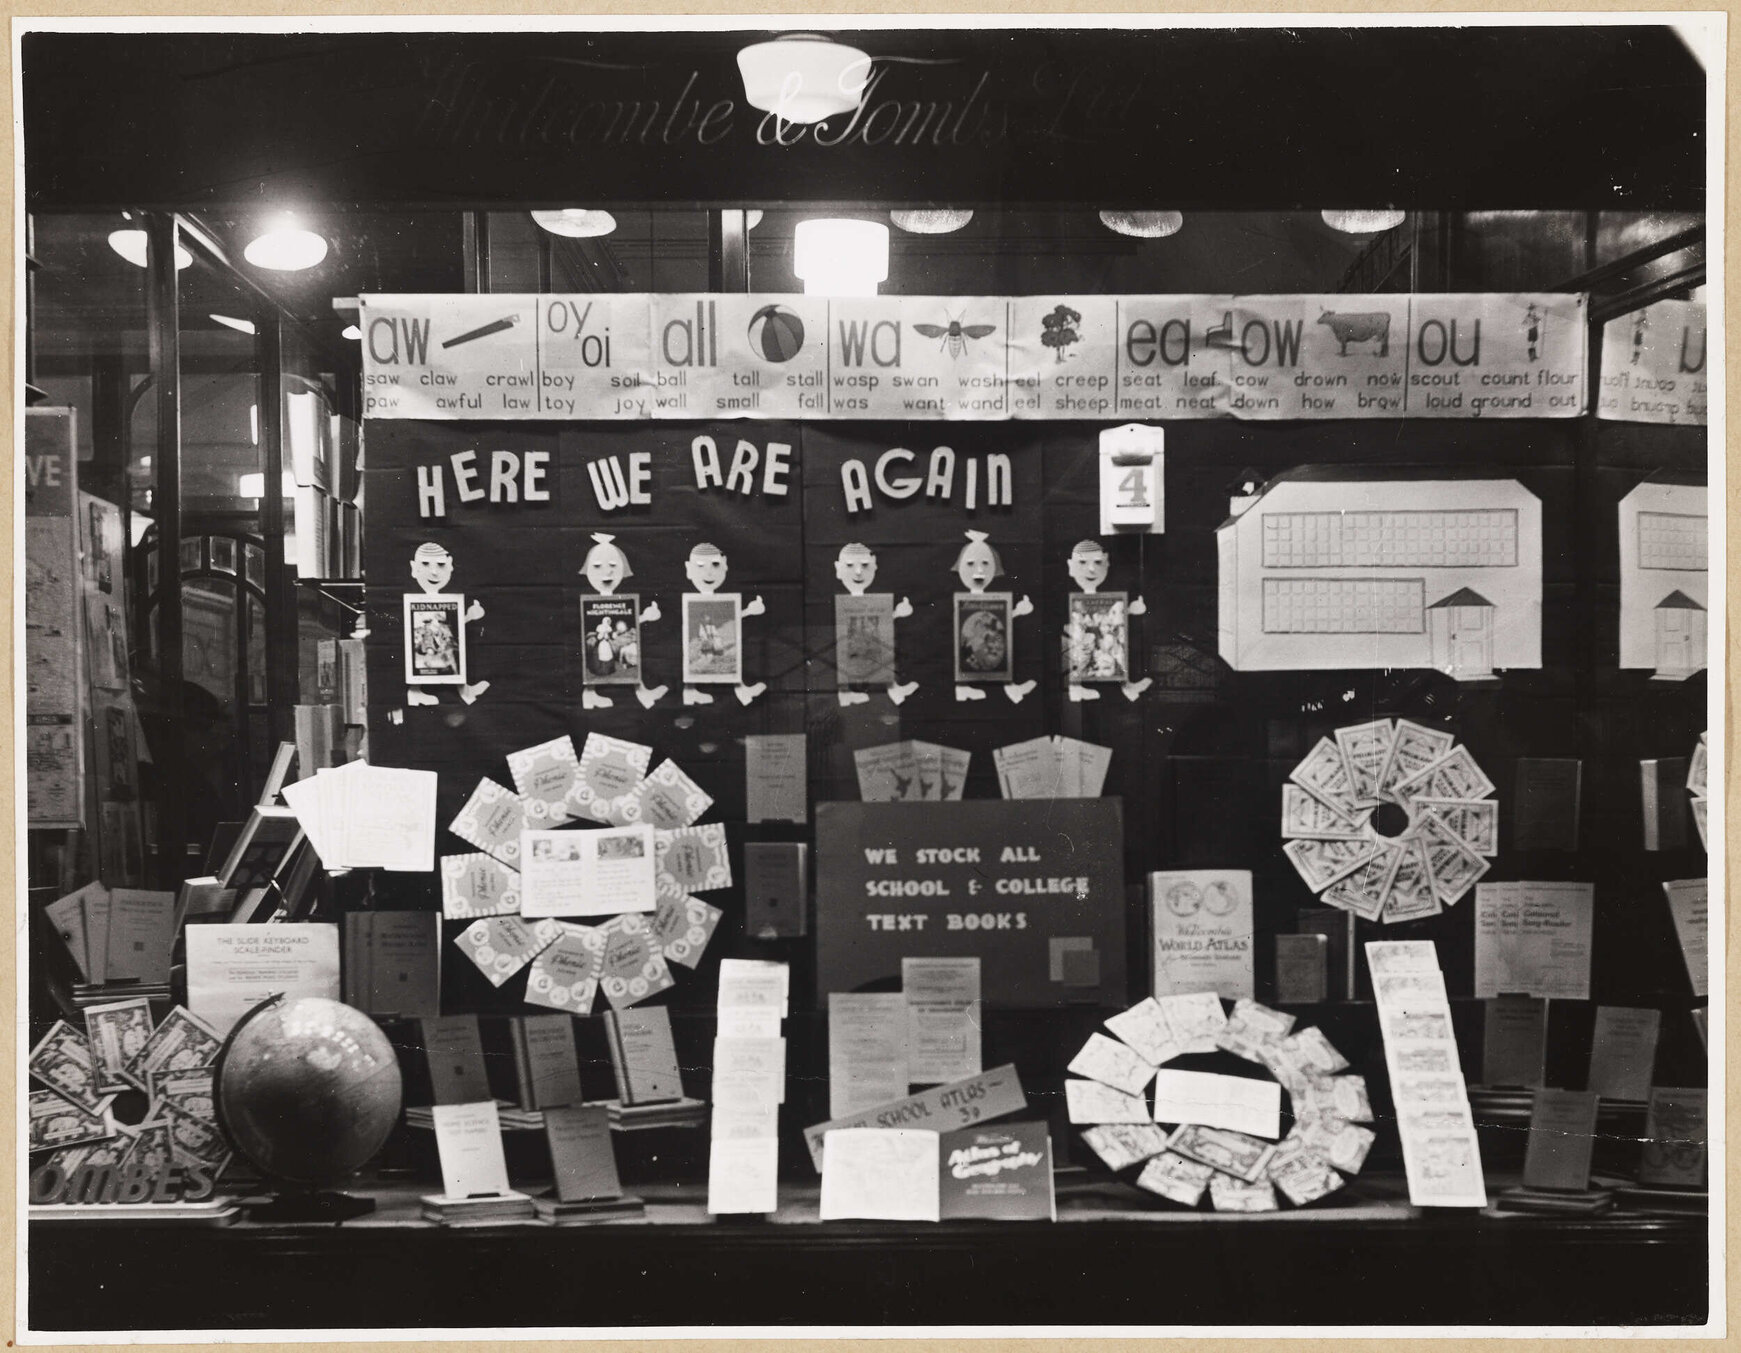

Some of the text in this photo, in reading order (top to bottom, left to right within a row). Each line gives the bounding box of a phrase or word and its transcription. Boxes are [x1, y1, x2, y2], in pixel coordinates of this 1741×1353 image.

[757, 68, 809, 146] &
[547, 300, 592, 339] oy
[368, 316, 430, 365] aw
[662, 300, 717, 367] all
[1126, 318, 1190, 367] ea
[1240, 318, 1303, 367] ow
[1418, 318, 1481, 367] ou
[581, 327, 611, 367] oi
[840, 320, 901, 367] wa
[366, 371, 534, 387] saw claw crawl
[542, 371, 575, 391] boy
[657, 371, 823, 387] ball tall stall
[834, 372, 1004, 391] wasp swan wash
[1015, 371, 1109, 391] eel creep
[1122, 371, 1217, 387] seat leaf
[1235, 371, 1402, 387] cow drown now
[1410, 369, 1577, 387] scout count flour
[366, 393, 530, 413] paw awful law
[545, 396, 645, 414] toy joy
[656, 393, 823, 410] wall small fall
[834, 393, 1003, 410] was want wand
[1015, 394, 1109, 413] eel sheep
[1120, 396, 1216, 410] meat neat
[1235, 393, 1401, 410] down how brow
[1426, 393, 1577, 416] loud ground out
[417, 435, 1013, 518] HERE WE ARE AGAIN
[1118, 467, 1148, 504] 4
[410, 603, 458, 611] KIDNAPPED
[586, 608, 632, 616] NIGHTINGALE
[864, 846, 1041, 865] WE STOCK ALL
[865, 876, 1090, 896] SCHOOL & COLLEGE
[866, 912, 1028, 930] TEXT BOOKS
[1159, 938, 1249, 952] WORLD ATLAS
[877, 1101, 933, 1129] SCHOOL
[939, 1082, 986, 1110] ATLAS
